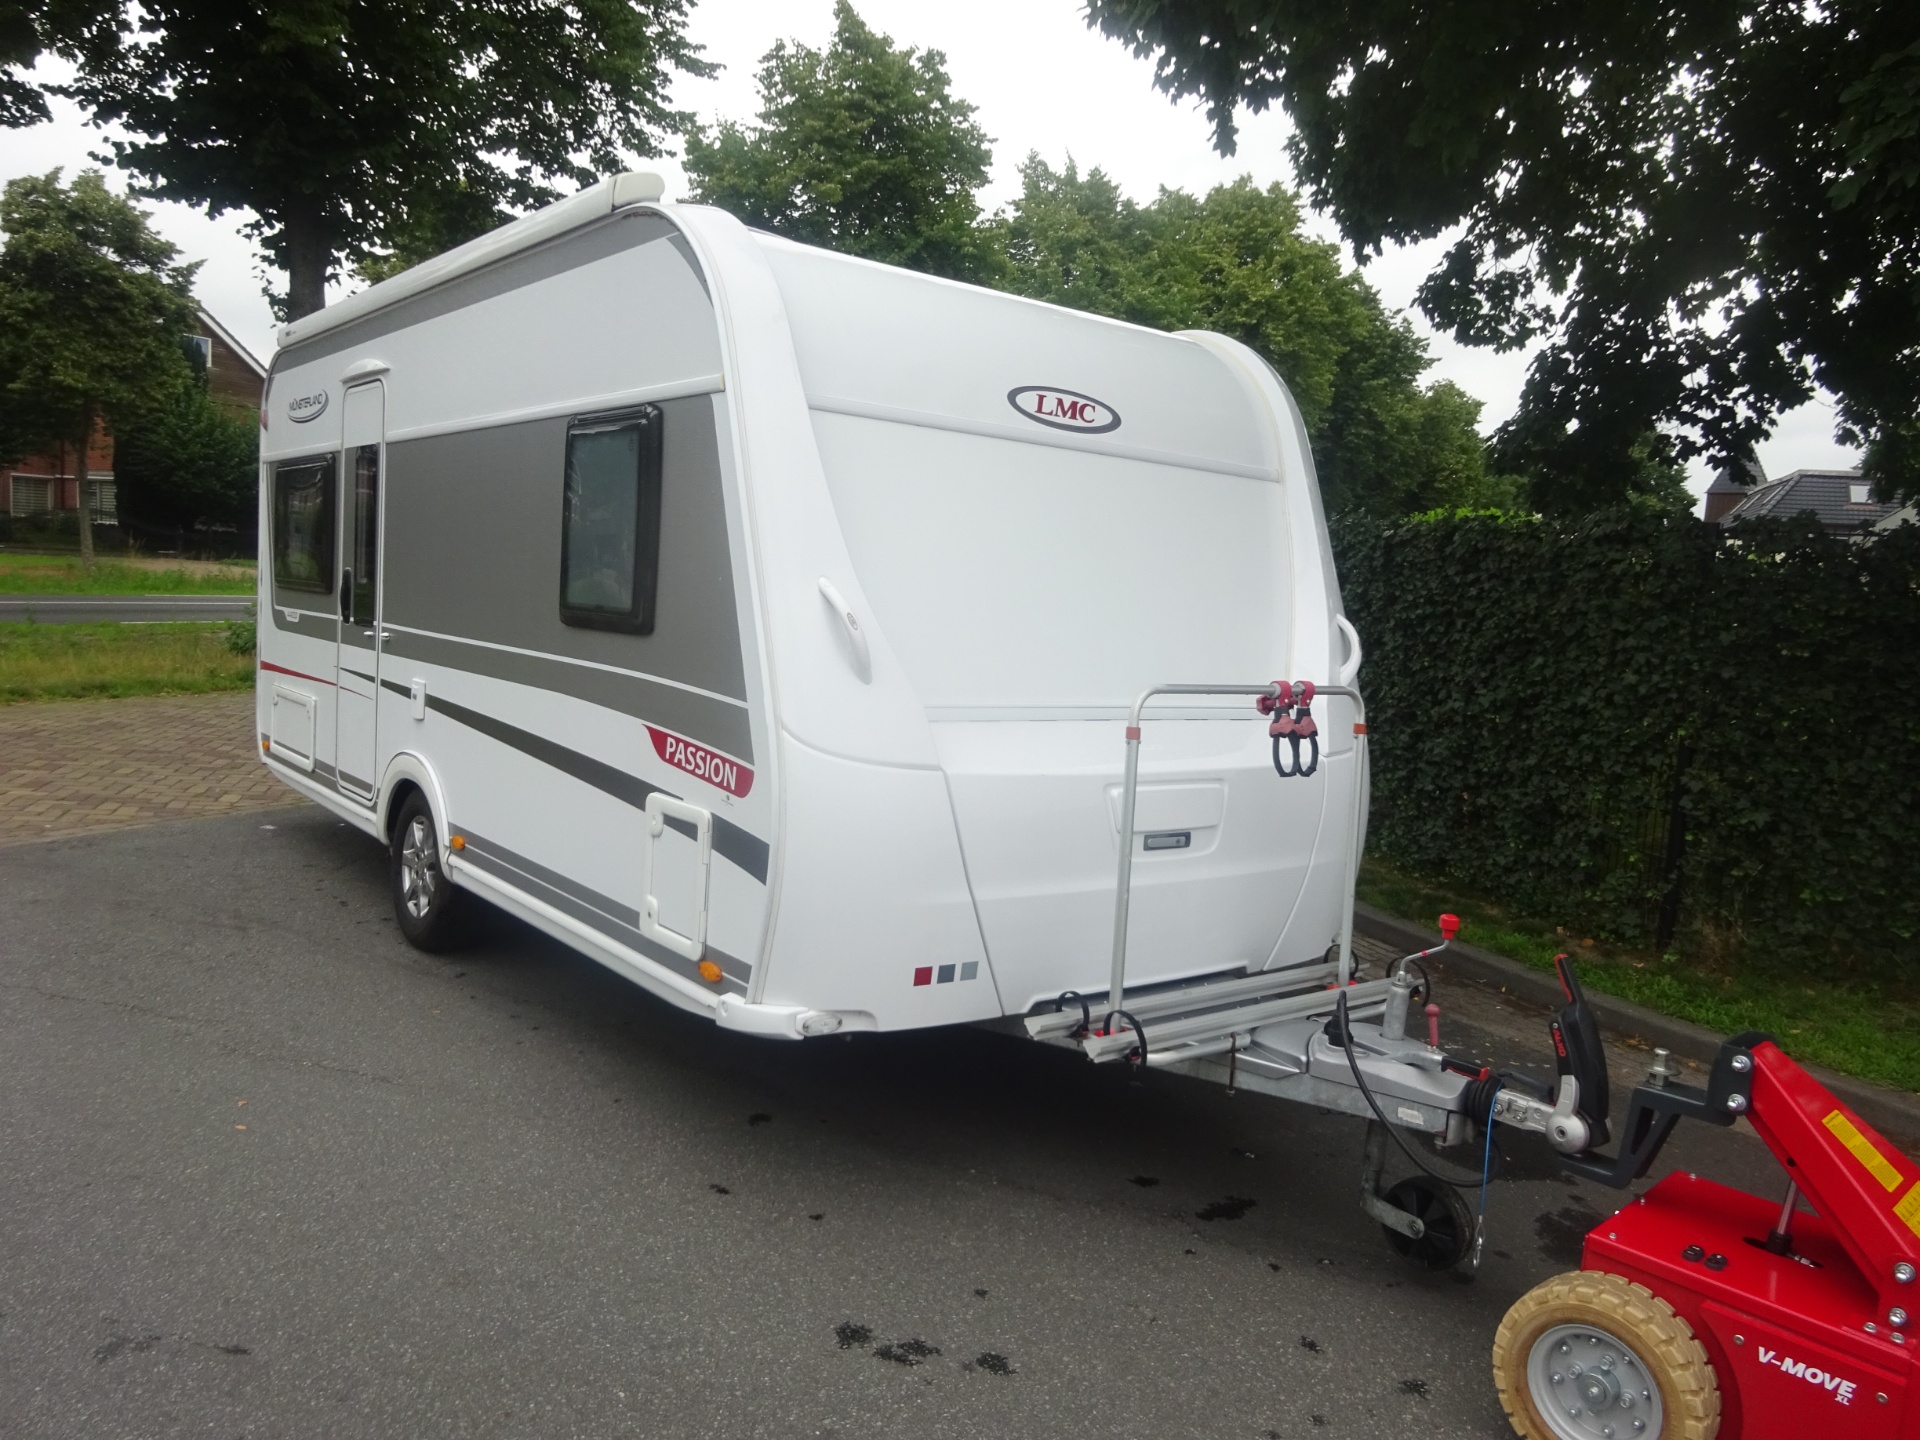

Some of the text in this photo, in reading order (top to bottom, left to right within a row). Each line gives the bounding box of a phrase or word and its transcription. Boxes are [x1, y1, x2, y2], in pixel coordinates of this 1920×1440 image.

[1034, 394, 1096, 424] LMC
[666, 737, 737, 791] PASSION
[1758, 1346, 1857, 1399] V-MOVE
[1834, 1394, 1850, 1406] XL
